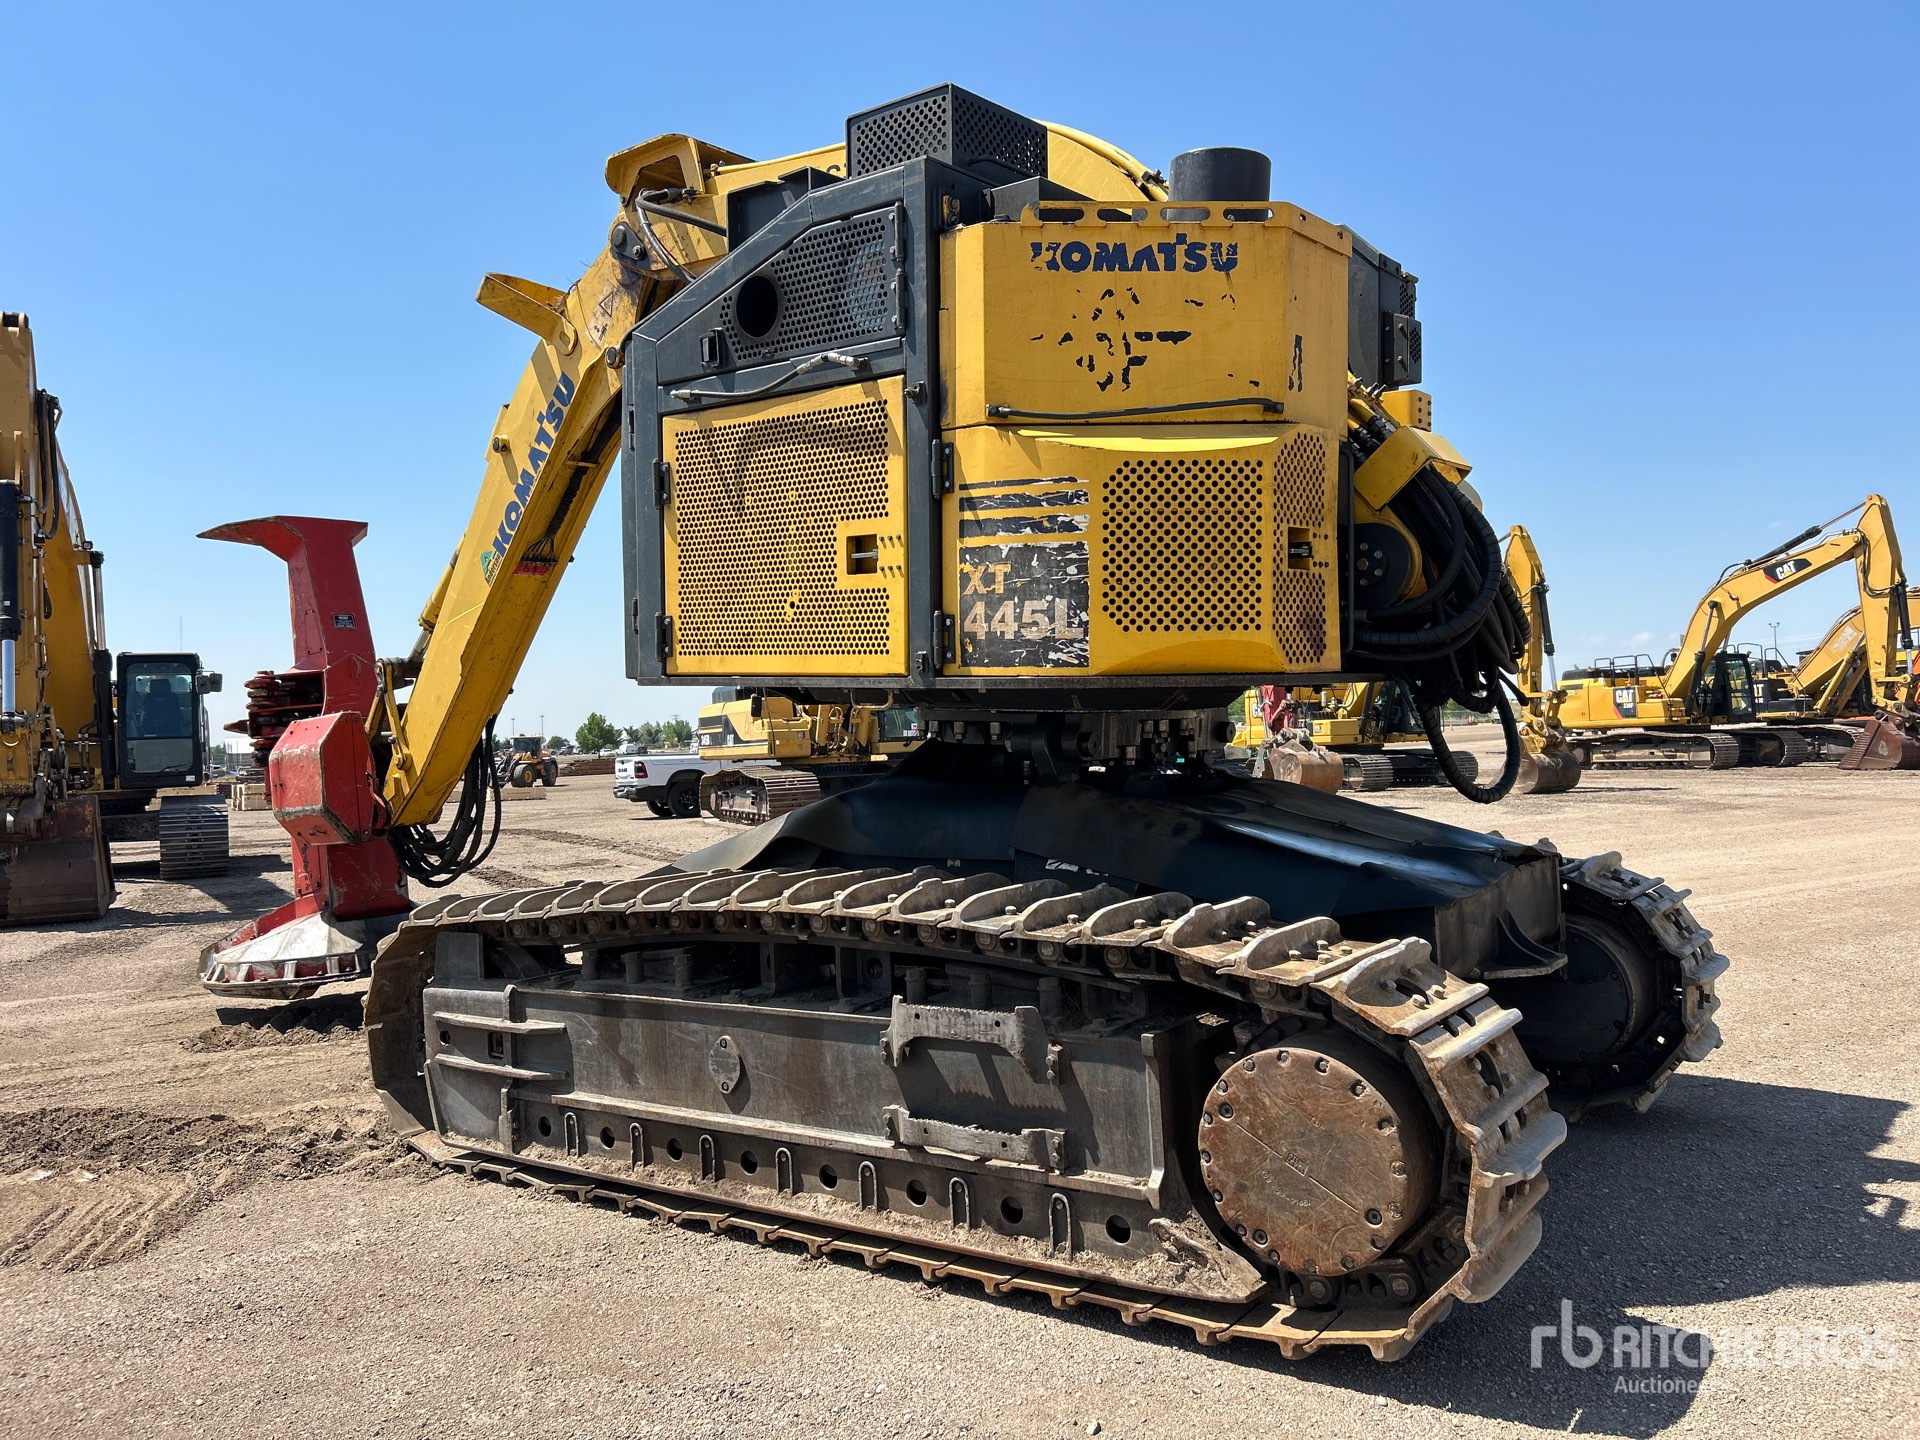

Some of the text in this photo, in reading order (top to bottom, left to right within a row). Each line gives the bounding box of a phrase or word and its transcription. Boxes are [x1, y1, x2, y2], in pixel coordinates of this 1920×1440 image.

[1030, 232, 1239, 273] KOMATSU
[492, 371, 575, 559] KOMATSU
[963, 563, 1011, 595] XT
[1775, 560, 1796, 580] CAT
[963, 598, 1085, 640] 445L
[1615, 689, 1634, 704] CAT
